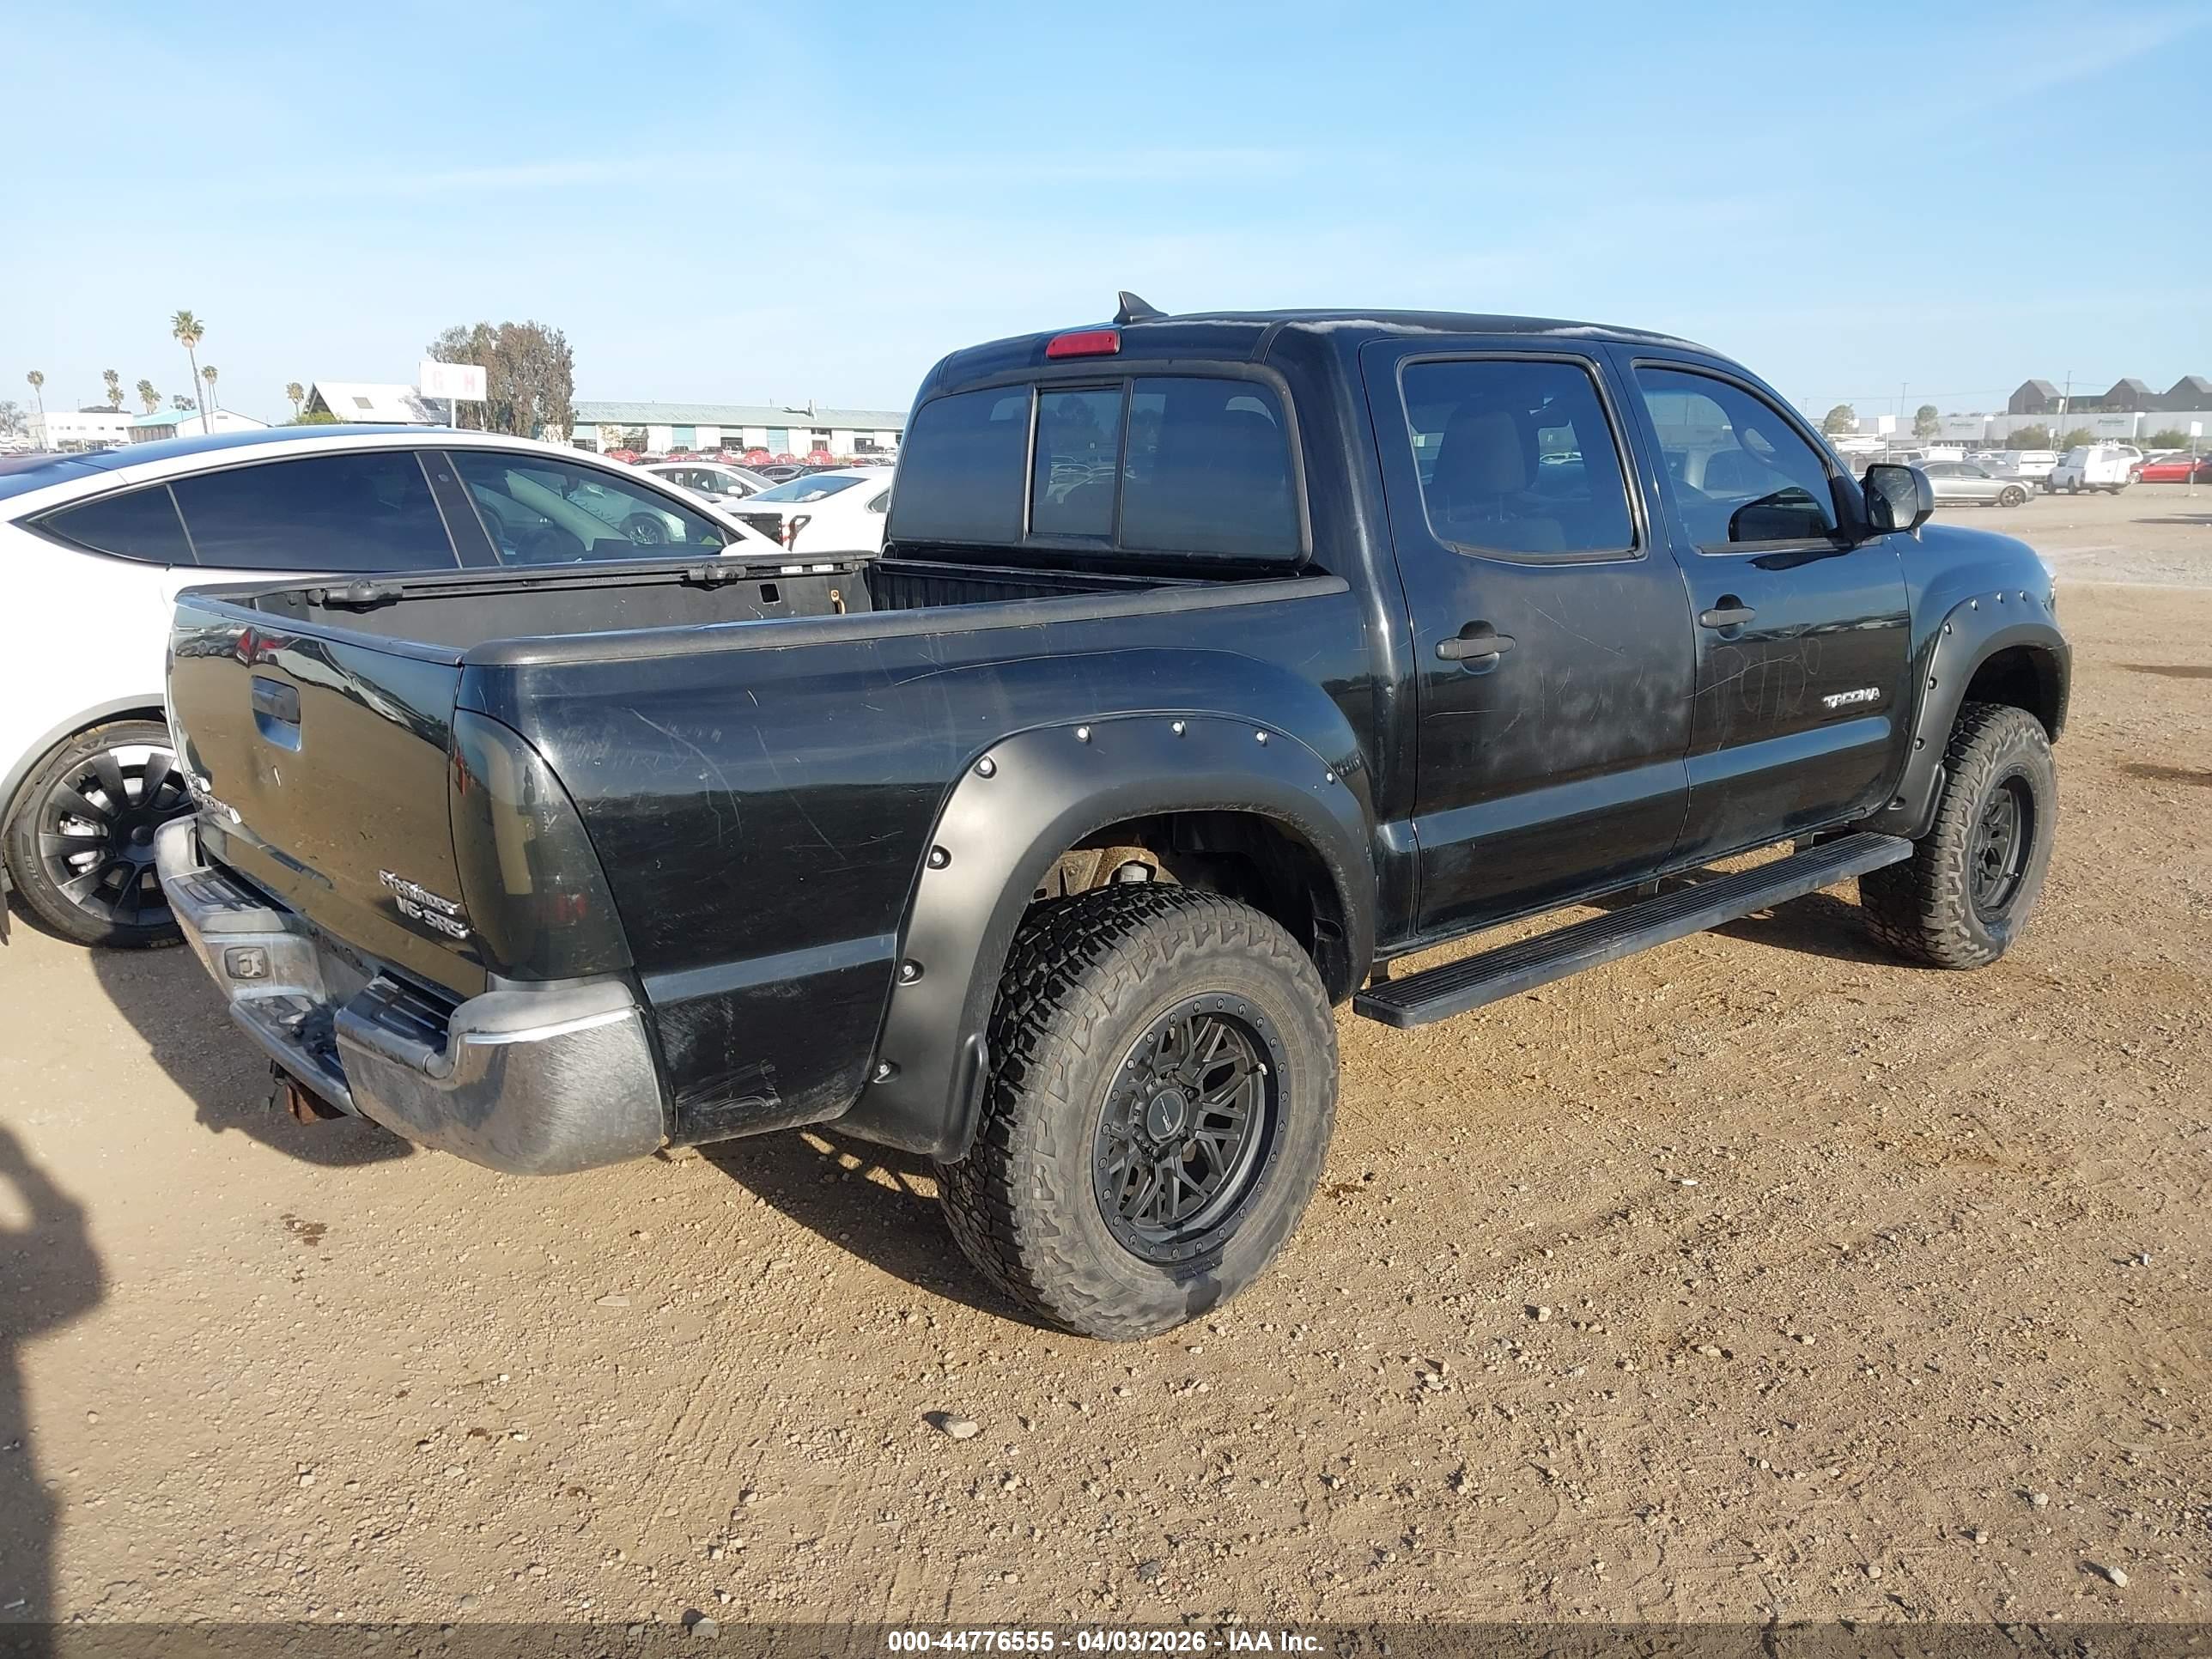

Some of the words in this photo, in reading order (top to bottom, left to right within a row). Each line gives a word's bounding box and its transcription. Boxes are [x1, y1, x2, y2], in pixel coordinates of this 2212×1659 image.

[1820, 687, 1881, 708] TACOMA
[395, 895, 422, 920] V6
[422, 908, 468, 940] SR5
